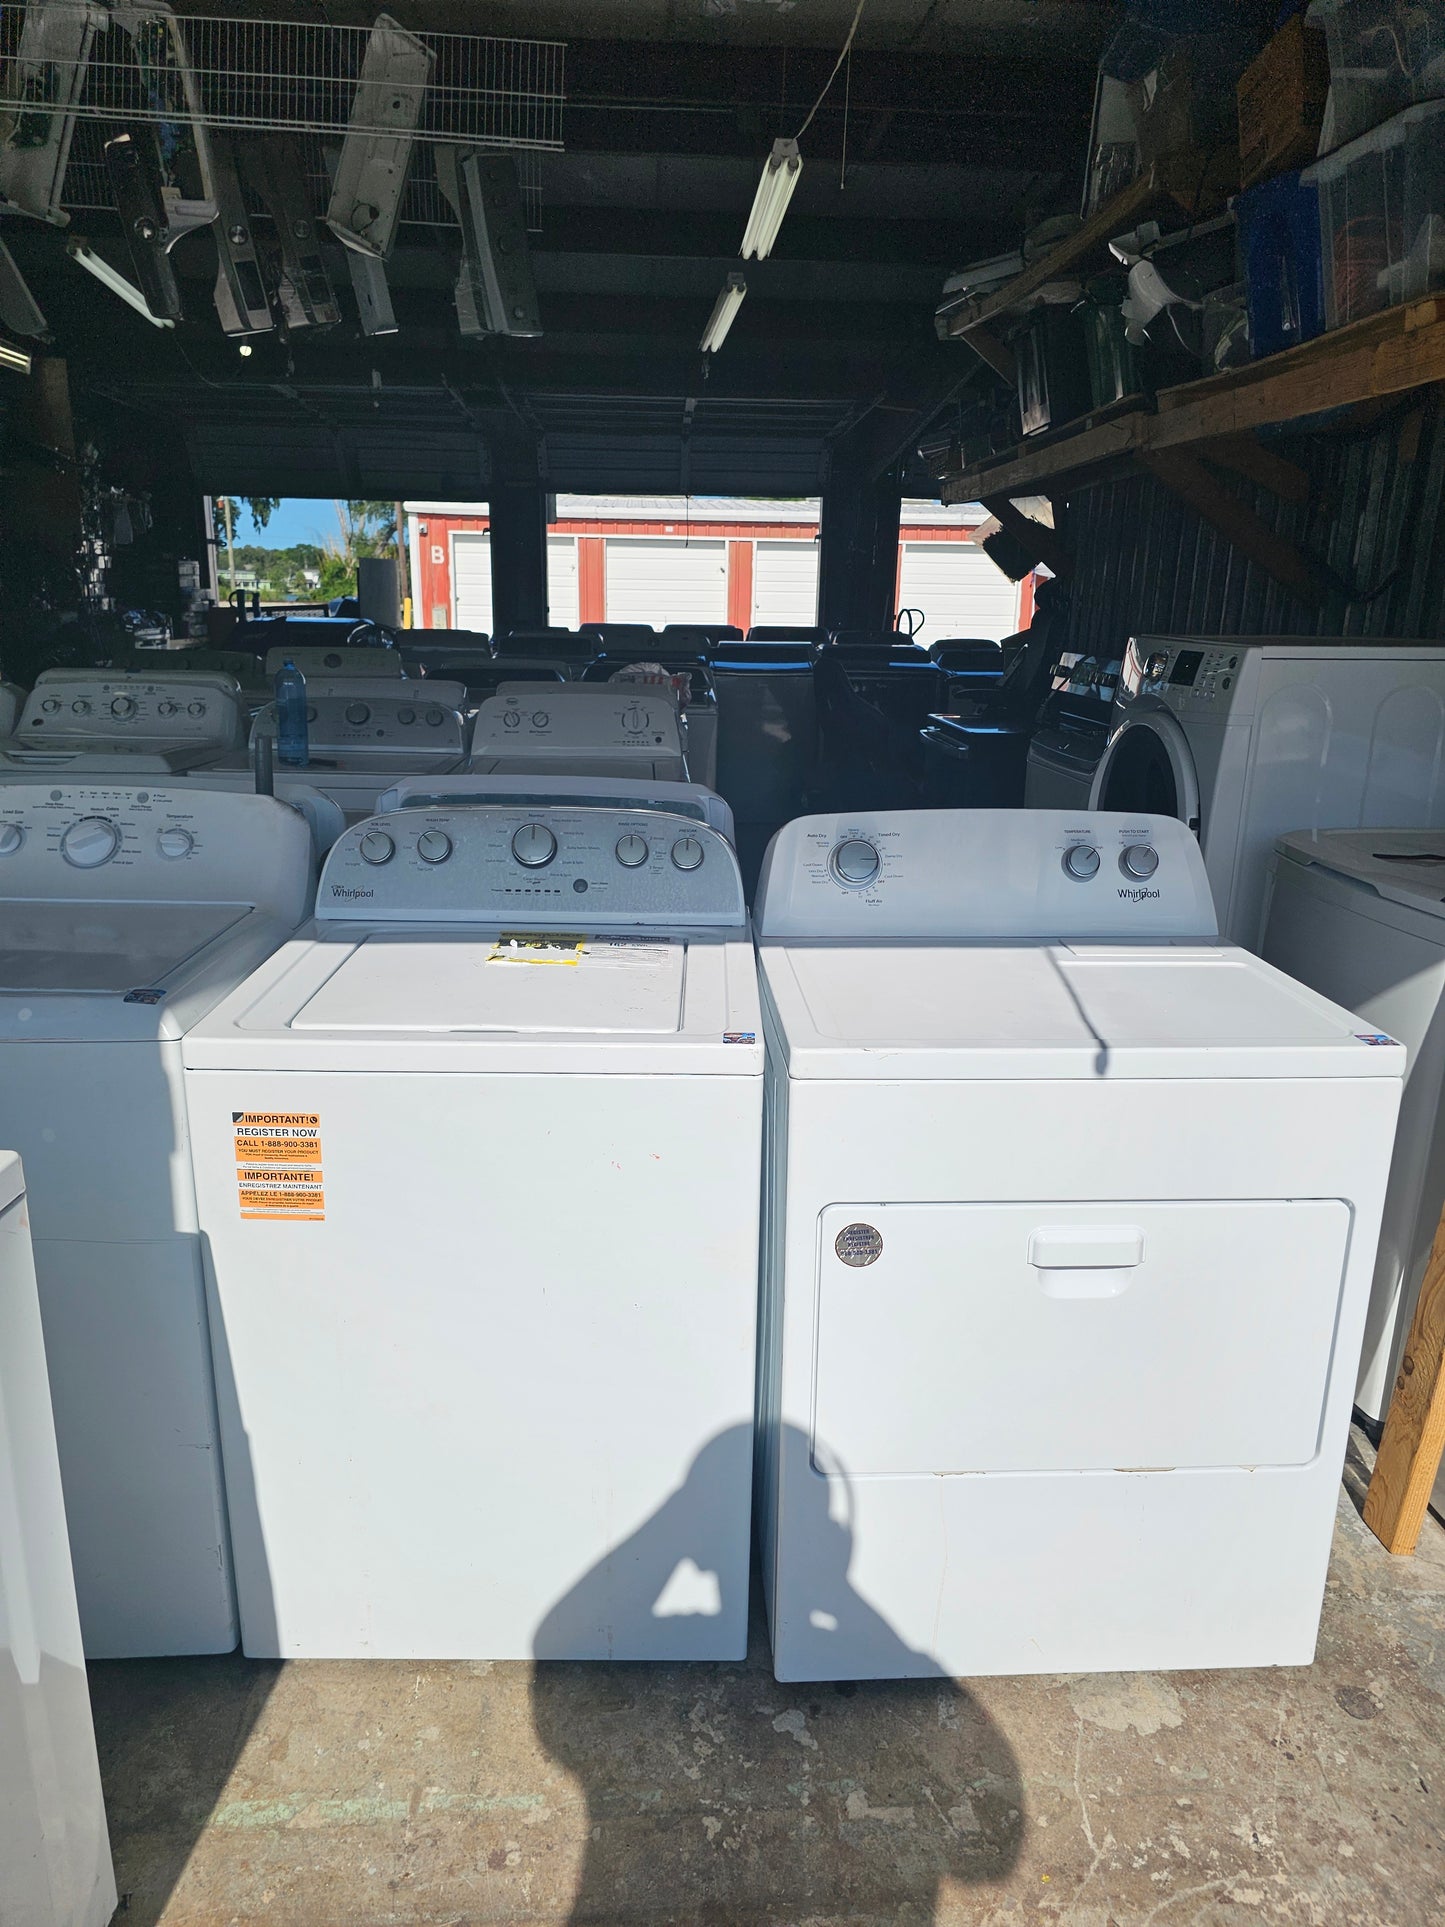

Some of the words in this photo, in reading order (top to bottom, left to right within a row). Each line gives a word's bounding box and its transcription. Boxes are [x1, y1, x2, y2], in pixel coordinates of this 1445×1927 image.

[431, 545, 444, 564] B
[332, 888, 374, 900] Whirlpool
[1117, 888, 1160, 901] Whirlpool
[245, 1115, 309, 1124] IMPORTANT!
[237, 1128, 289, 1136] REGISTER
[292, 1129, 317, 1137] NOW
[261, 1140, 318, 1148] 1-888-900-3381
[244, 1172, 314, 1181] IMPORTANTE!
